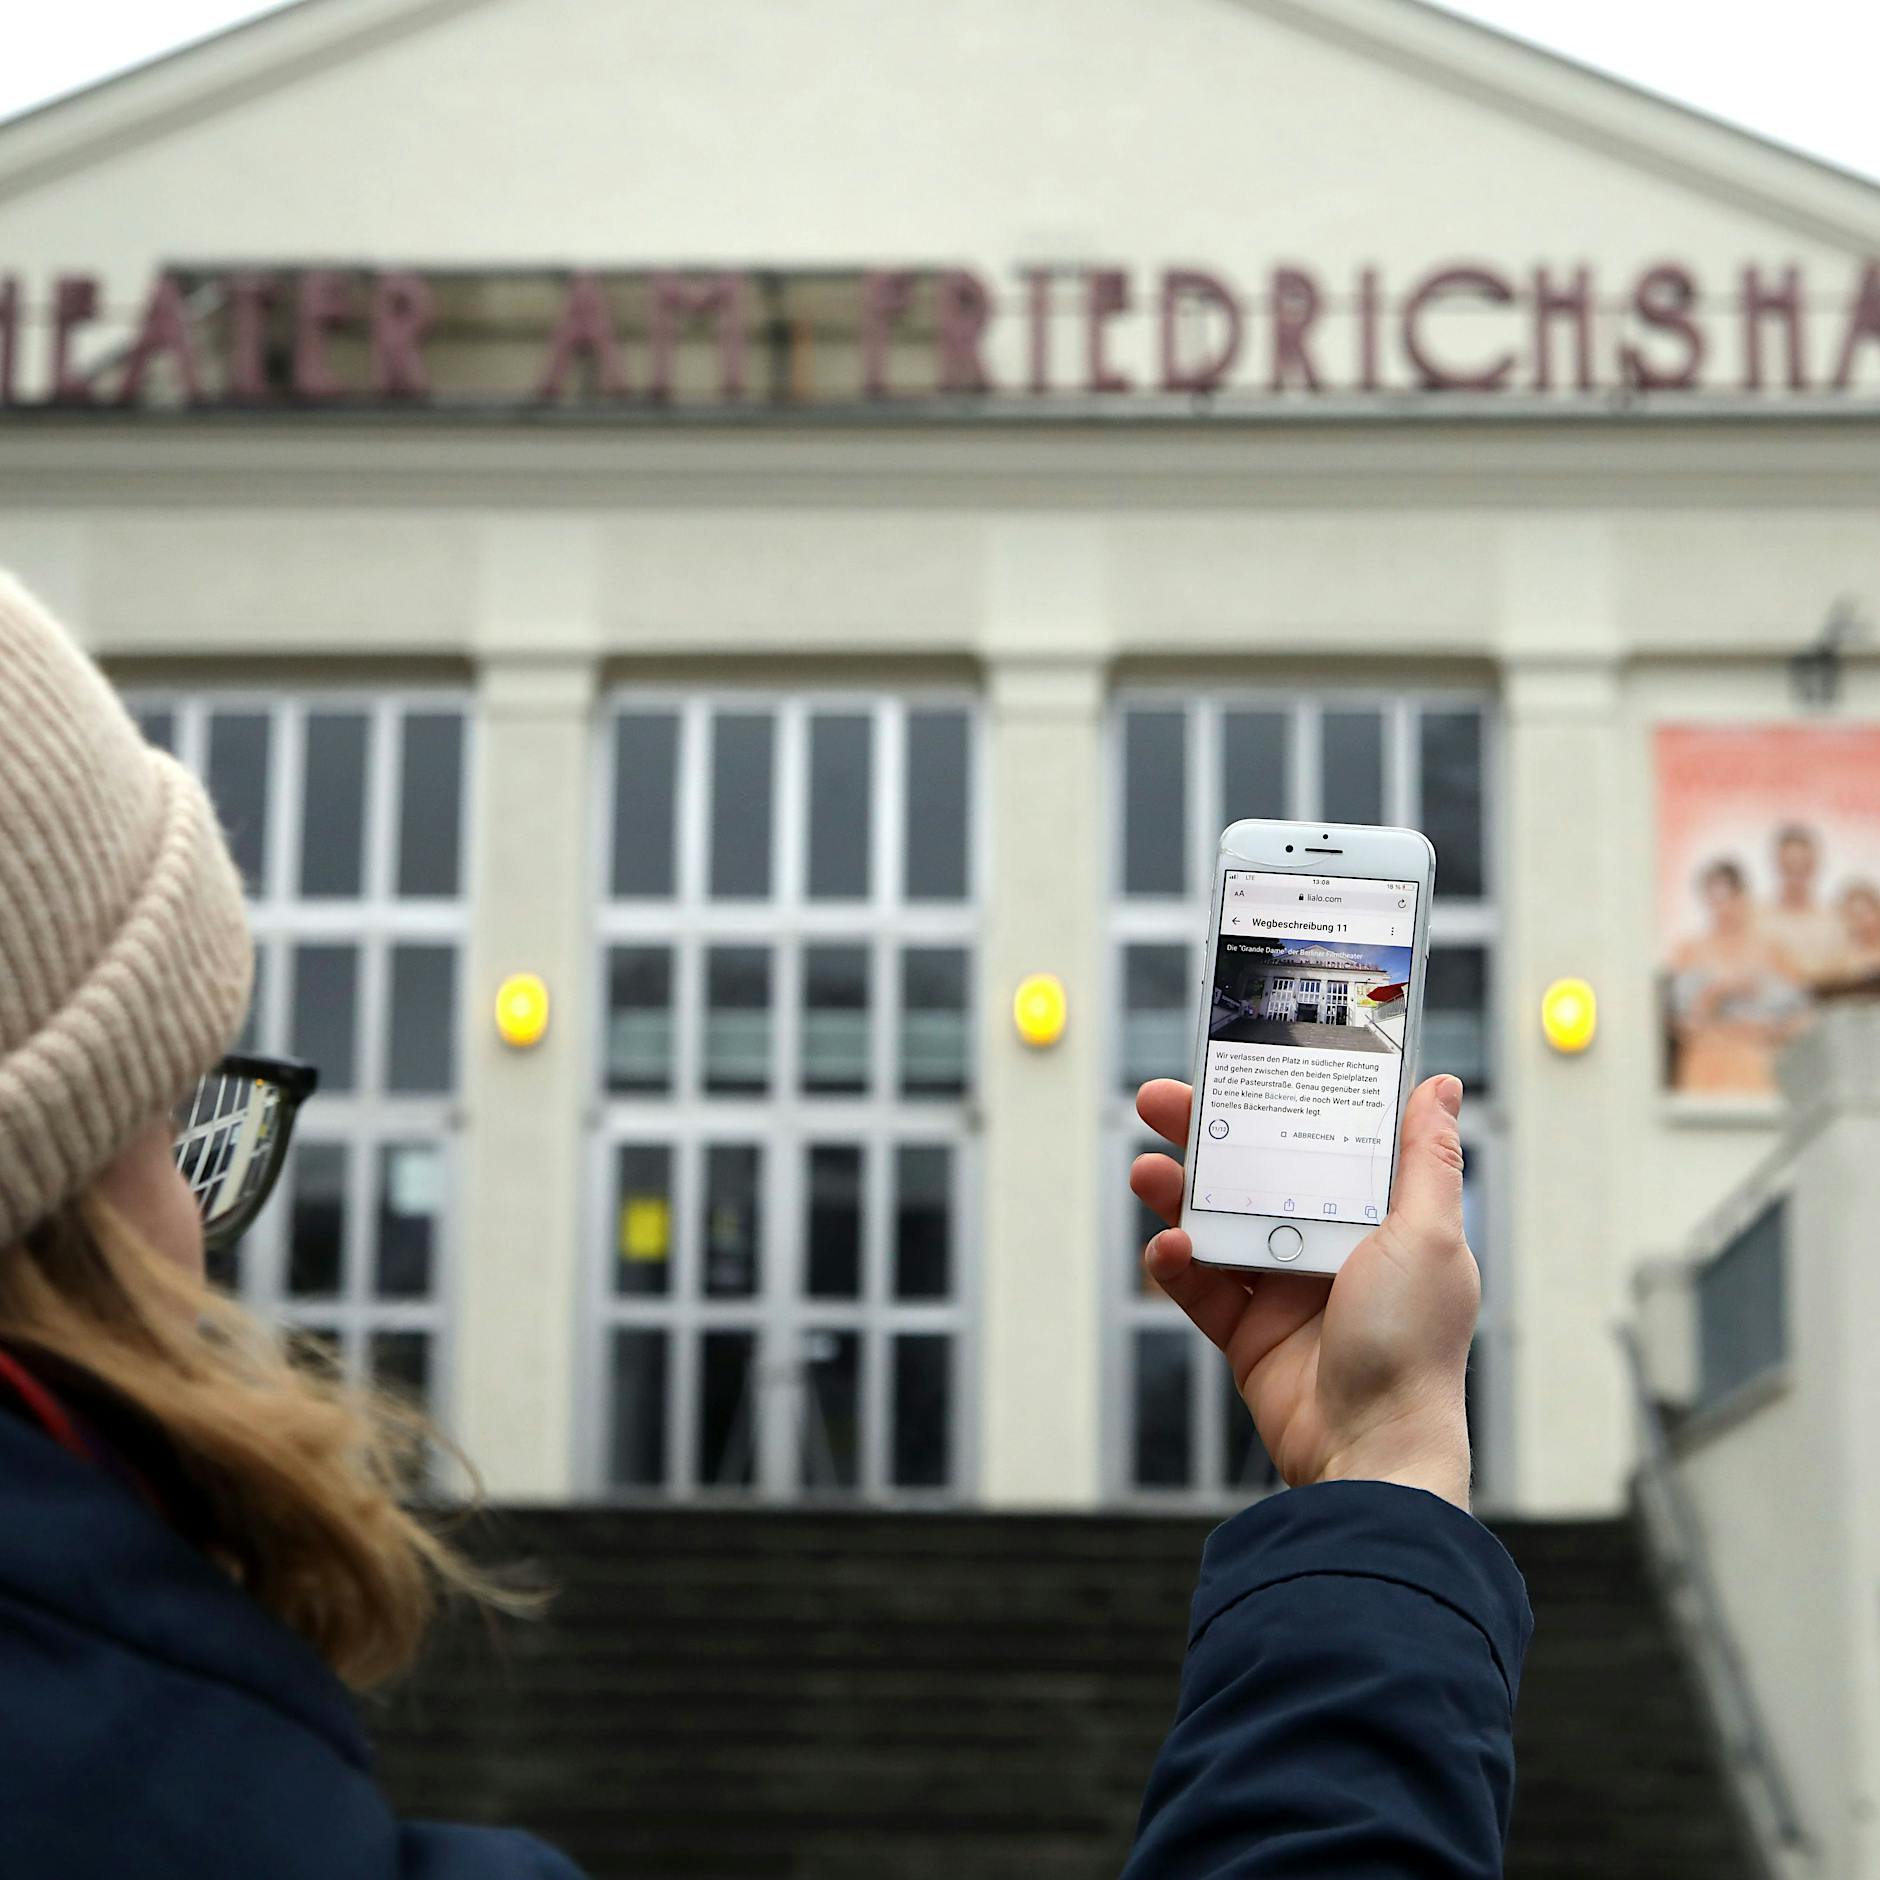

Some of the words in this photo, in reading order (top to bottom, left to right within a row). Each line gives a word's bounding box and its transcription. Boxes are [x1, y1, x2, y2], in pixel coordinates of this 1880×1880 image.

[533, 268, 748, 398] AM
[1307, 893, 1342, 904] lialo.com
[1252, 917, 1334, 933] Wegbeschreibung
[1336, 923, 1348, 933] 11
[1226, 943, 1238, 952] Die
[1287, 948, 1299, 956] der
[1229, 1053, 1265, 1062] verlassen
[1266, 1055, 1281, 1063] den
[1281, 1056, 1301, 1064] Platz
[1311, 1059, 1345, 1068] südlicher
[1346, 1061, 1379, 1072] Richtung
[1230, 1066, 1253, 1074] gehen
[1254, 1067, 1289, 1076] zwischen
[1290, 1069, 1305, 1077] den
[1305, 1070, 1331, 1079] beiden
[1213, 1076, 1226, 1084] auf
[1295, 1082, 1320, 1090] Genau
[1241, 1090, 1263, 1098] kleine
[1312, 1096, 1331, 1104] noch
[1332, 1098, 1351, 1106] Wert
[1351, 1099, 1365, 1107] auf
[1365, 1100, 1386, 1108] tradi-
[1211, 1101, 1242, 1109] tionelles
[1243, 1102, 1305, 1113] Bäckerhandwerk
[1292, 1131, 1335, 1140] ABBRECHEN
[1354, 1136, 1382, 1144] WEITER
